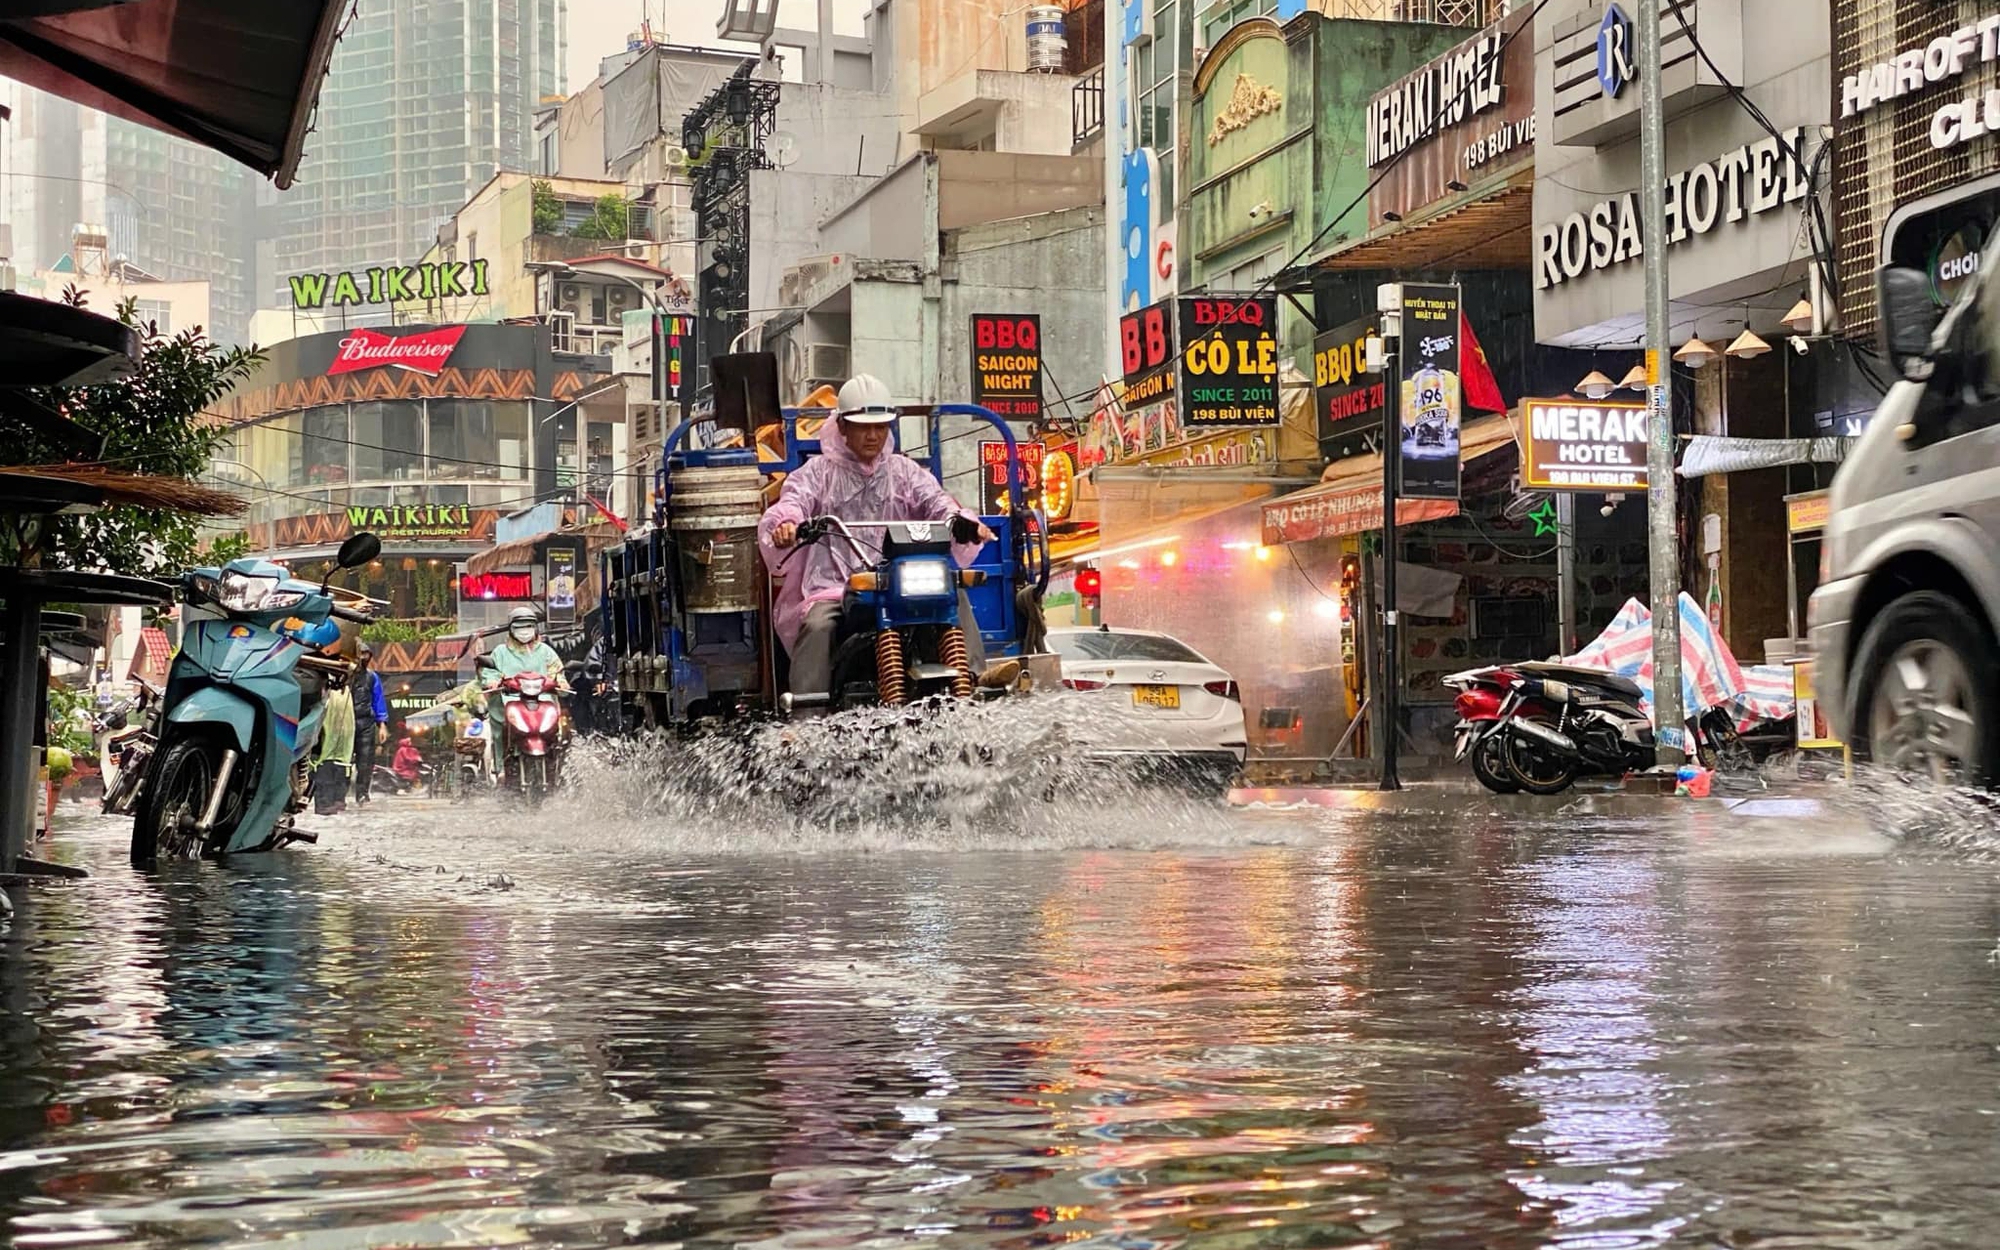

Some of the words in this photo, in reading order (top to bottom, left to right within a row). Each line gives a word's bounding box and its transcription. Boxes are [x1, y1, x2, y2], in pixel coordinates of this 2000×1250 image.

[1367, 69, 1434, 168] MERAKI
[1439, 32, 1501, 130] HOTEL
[1463, 139, 1485, 170] 198
[1488, 120, 1512, 158] BÙI
[1537, 193, 1643, 291] ROSA
[1664, 126, 1810, 246] HOTEL
[289, 258, 490, 309] WAIKIKI
[1194, 301, 1264, 327] BBQ
[977, 319, 1036, 351] BBQ
[338, 337, 454, 361] Budweiser
[1186, 331, 1230, 375] CÔ
[1237, 331, 1276, 384] LỆ
[979, 356, 1038, 371] SAIGON
[1316, 343, 1352, 388] BBQ
[983, 374, 1033, 390] NIGHT
[1191, 389, 1235, 402] SINCE
[1242, 388, 1273, 401] 2011
[1330, 388, 1367, 421] SINCE
[1014, 402, 1039, 414] 2010
[1193, 410, 1216, 420] 198
[1219, 406, 1242, 420] BÙI
[1245, 403, 1275, 423] VIỆN
[1559, 444, 1631, 463] HOTEL
[346, 503, 471, 527] WAIKIKI
[1266, 508, 1288, 529] BBQ
[391, 528, 471, 537] RESTAURANT
[390, 698, 437, 709] WAIKIKI
